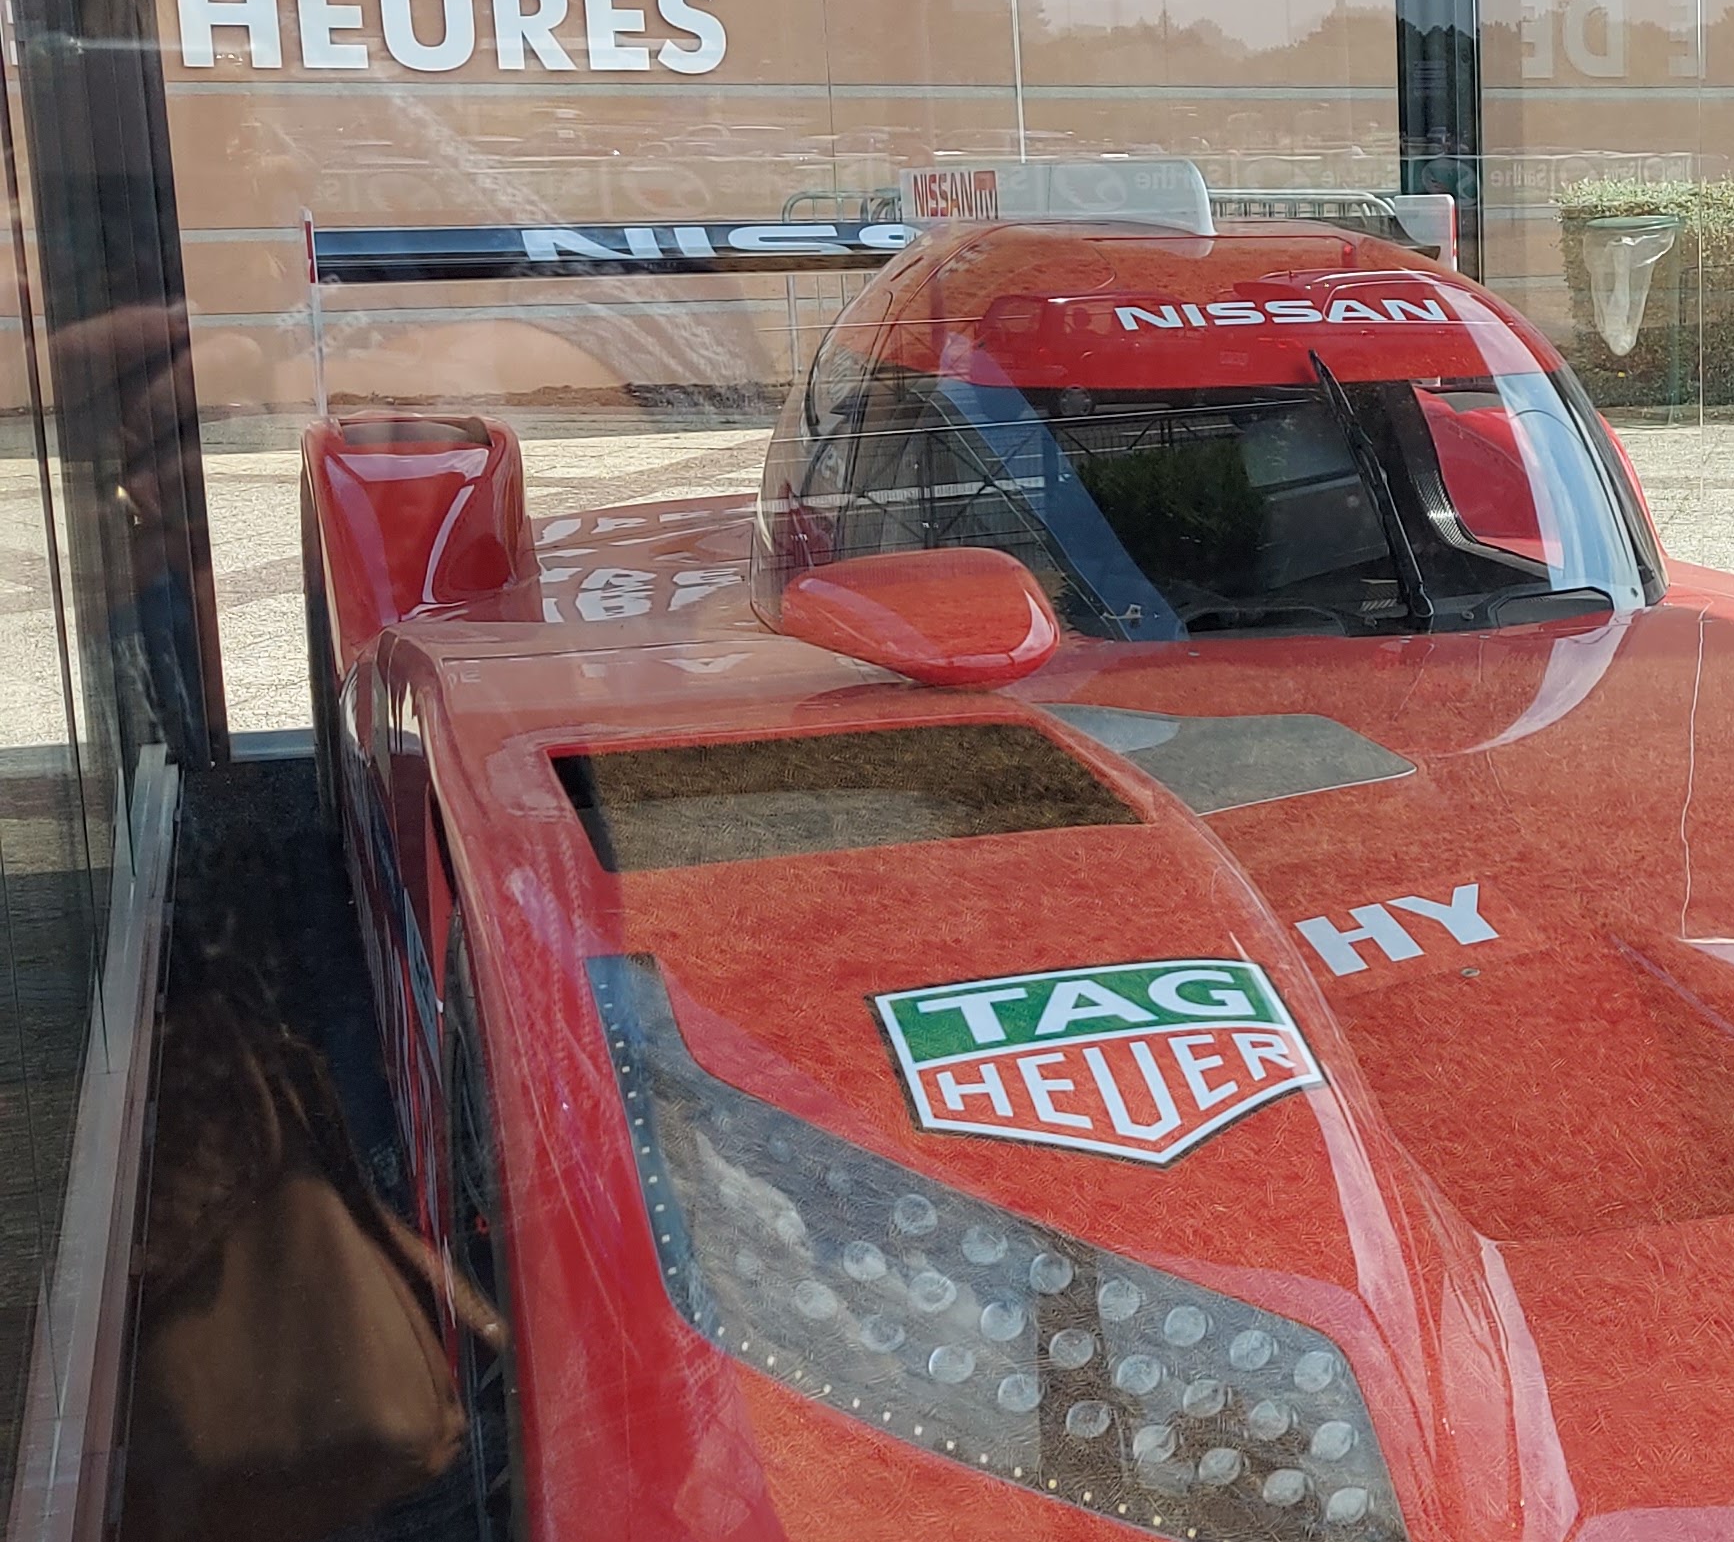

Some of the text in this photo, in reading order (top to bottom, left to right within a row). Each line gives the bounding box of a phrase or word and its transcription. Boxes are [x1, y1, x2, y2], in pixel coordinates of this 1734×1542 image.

[912, 171, 974, 218] NISSAN
[1111, 297, 1451, 331] NISSAN
[1293, 882, 1500, 977] HY
[916, 967, 1259, 1044] TAG
[936, 1032, 1295, 1143] HEUER
